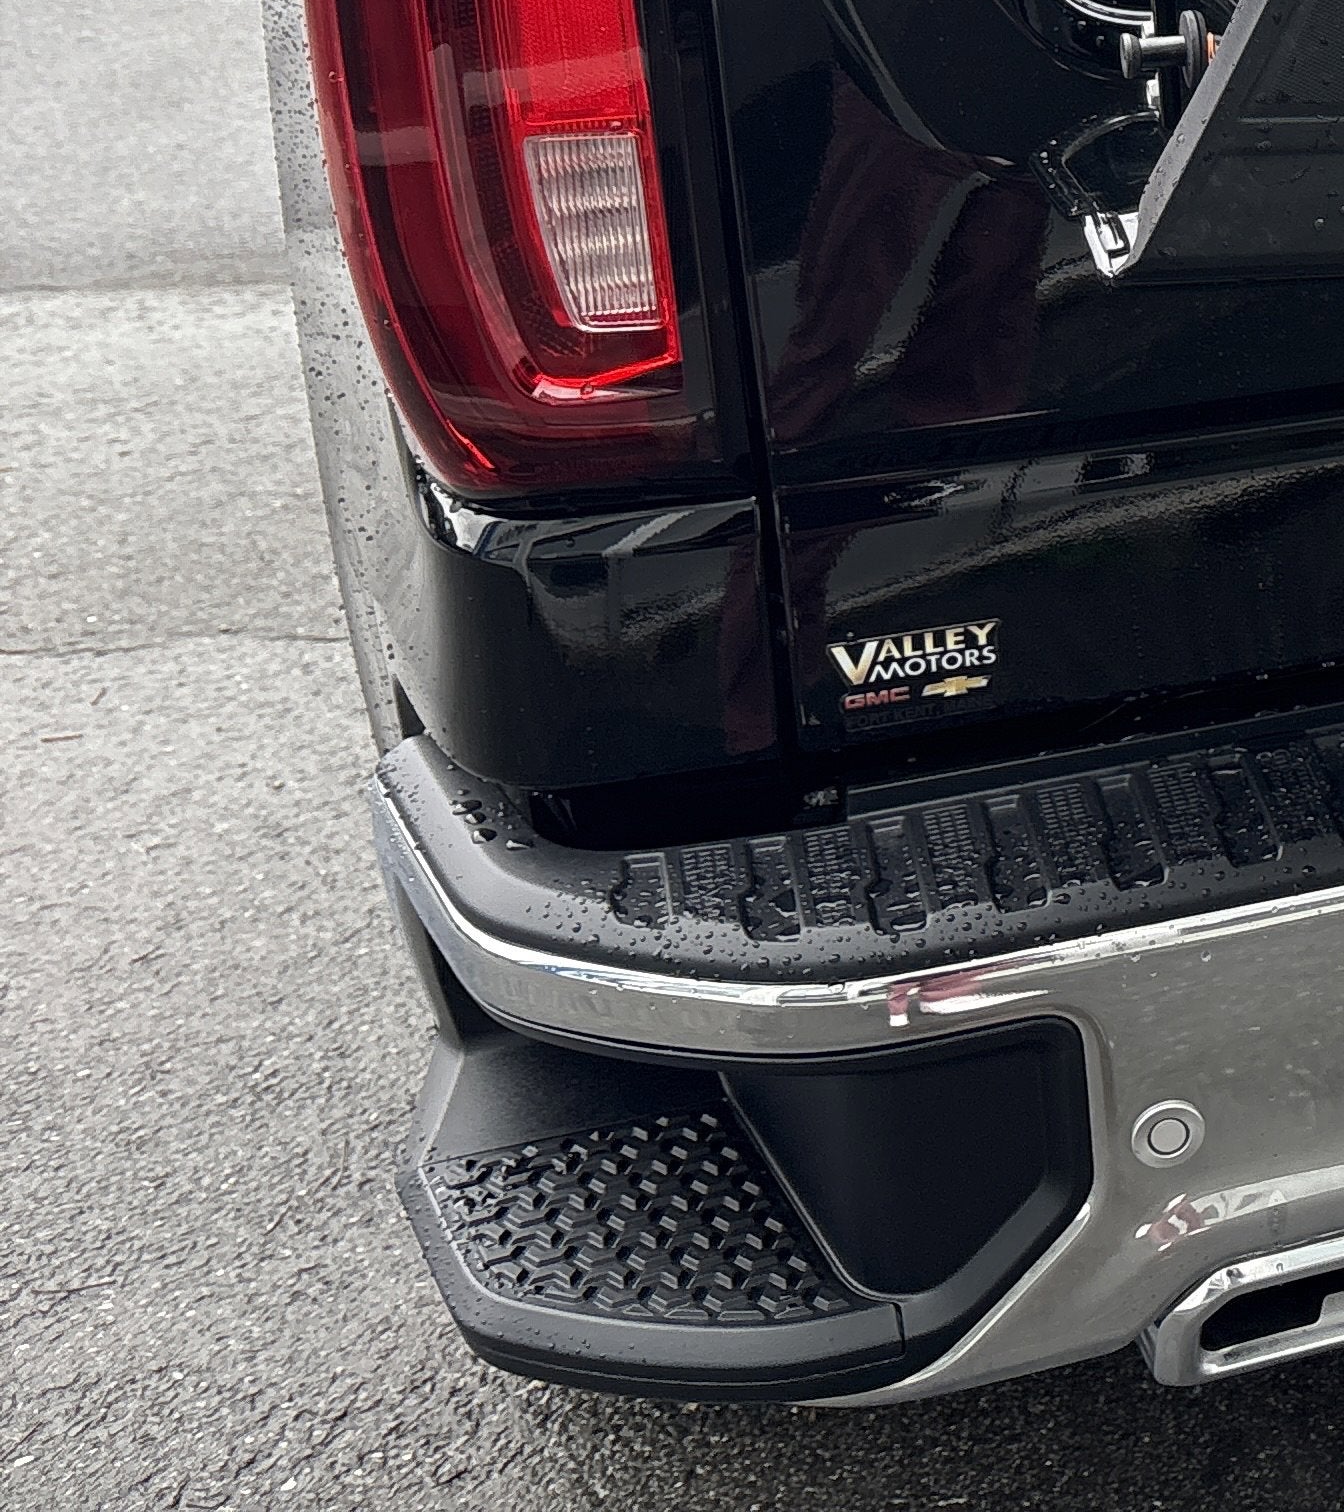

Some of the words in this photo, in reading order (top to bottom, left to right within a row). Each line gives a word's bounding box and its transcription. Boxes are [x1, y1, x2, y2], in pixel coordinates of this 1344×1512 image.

[830, 622, 997, 686] VALLEY
[869, 645, 998, 683] MOTORS
[844, 686, 911, 711] GMC
